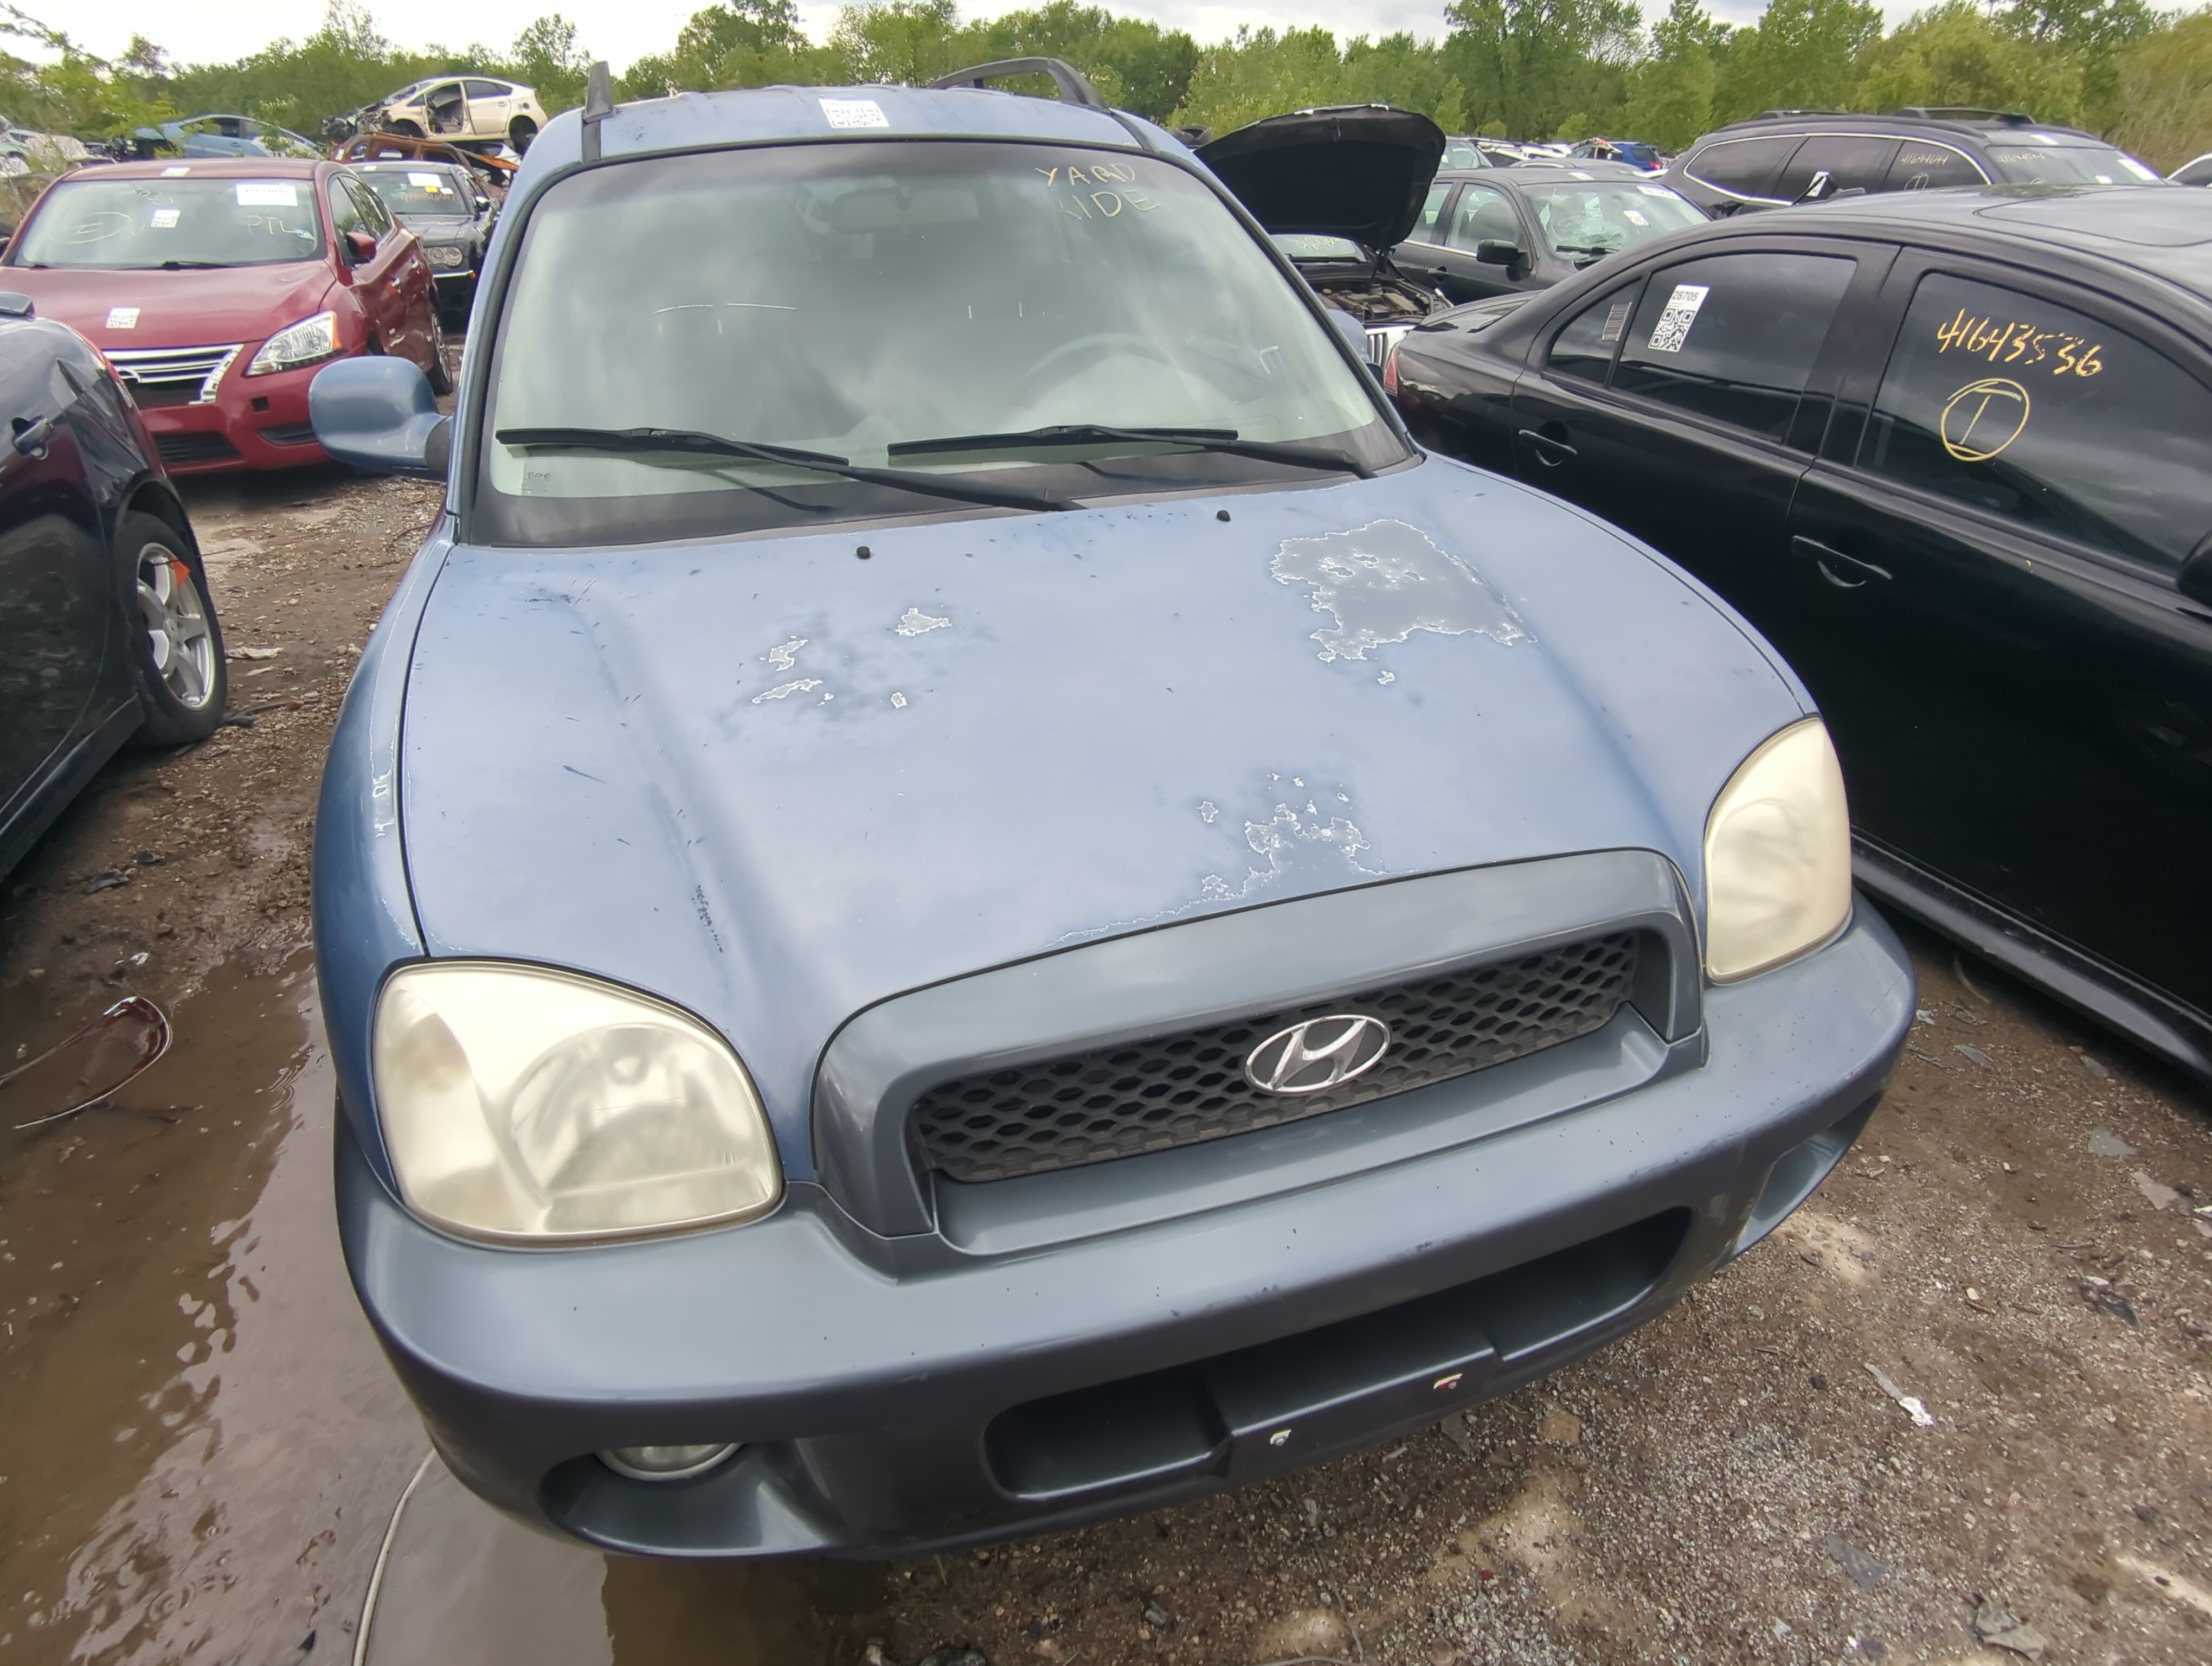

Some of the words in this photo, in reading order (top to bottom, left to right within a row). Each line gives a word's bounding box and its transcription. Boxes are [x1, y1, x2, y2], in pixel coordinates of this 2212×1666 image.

[1034, 163, 1136, 188] YARD
[1671, 291, 1699, 302] 28705
[1937, 307, 2102, 377] 41643536
